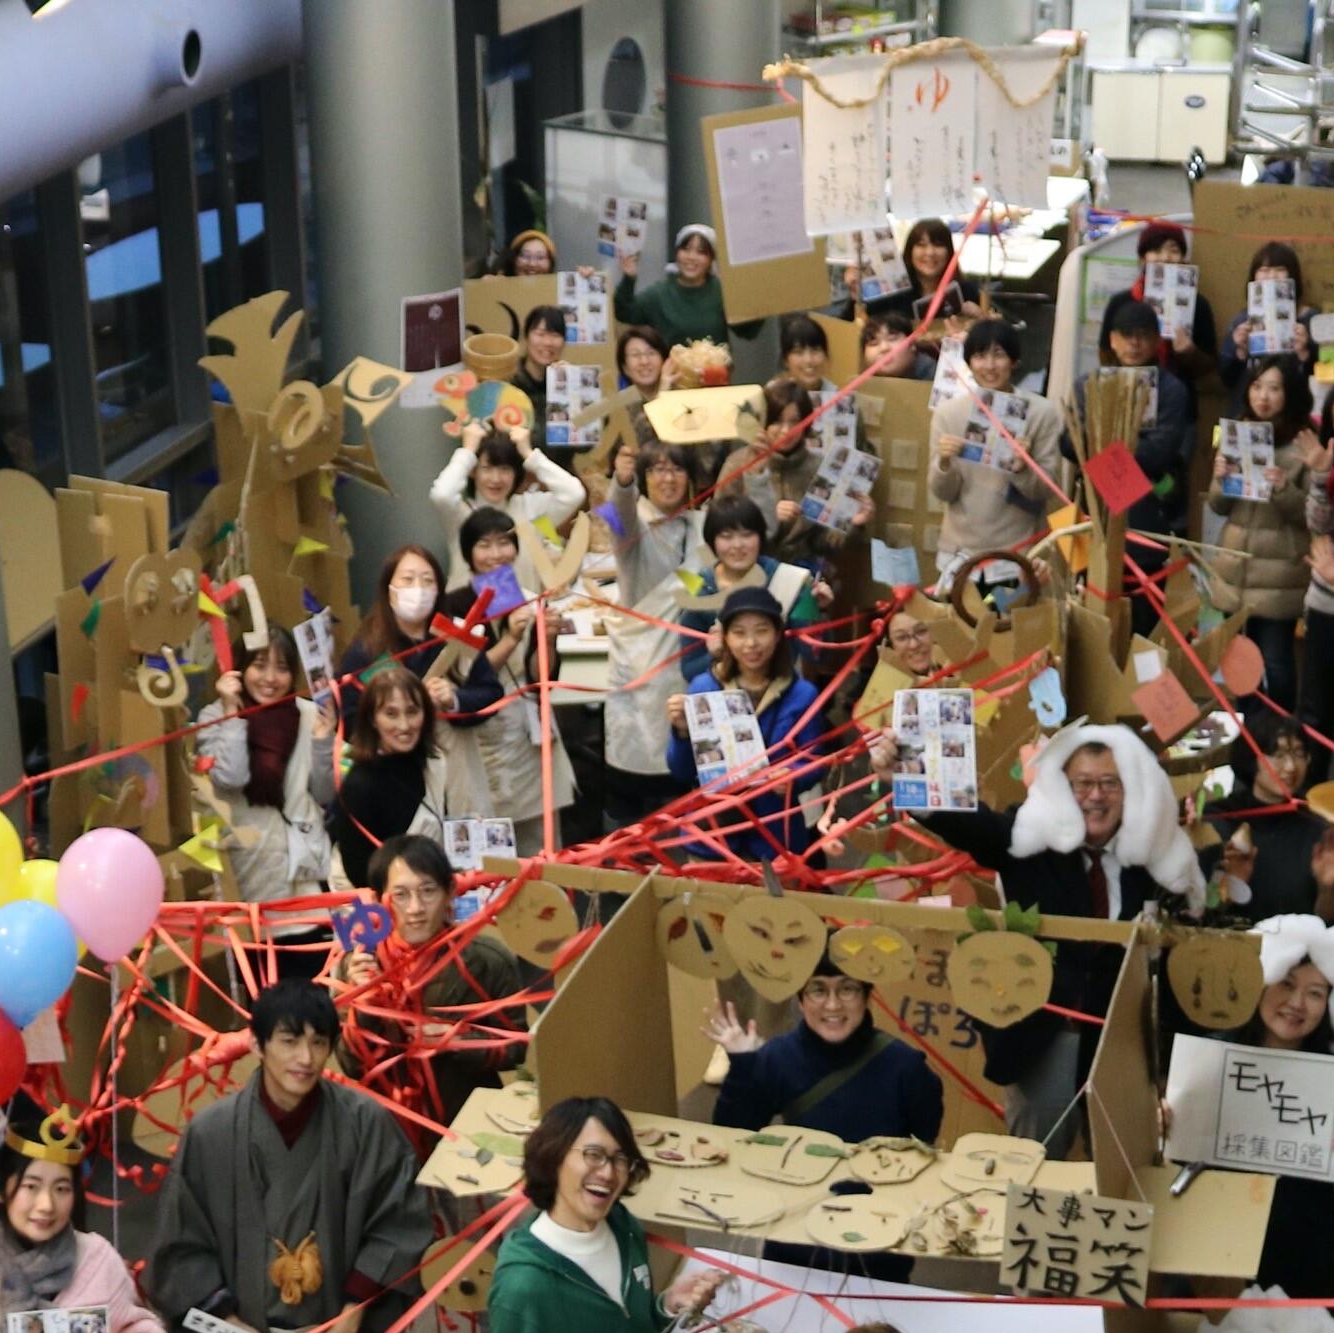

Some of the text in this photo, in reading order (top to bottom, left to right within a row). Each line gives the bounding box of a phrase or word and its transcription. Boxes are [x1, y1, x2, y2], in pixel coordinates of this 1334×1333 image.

[1228, 1060, 1327, 1136] モヤモヤ
[1016, 1187, 1150, 1232] 大事マン
[1006, 1222, 1147, 1310] 福笑
